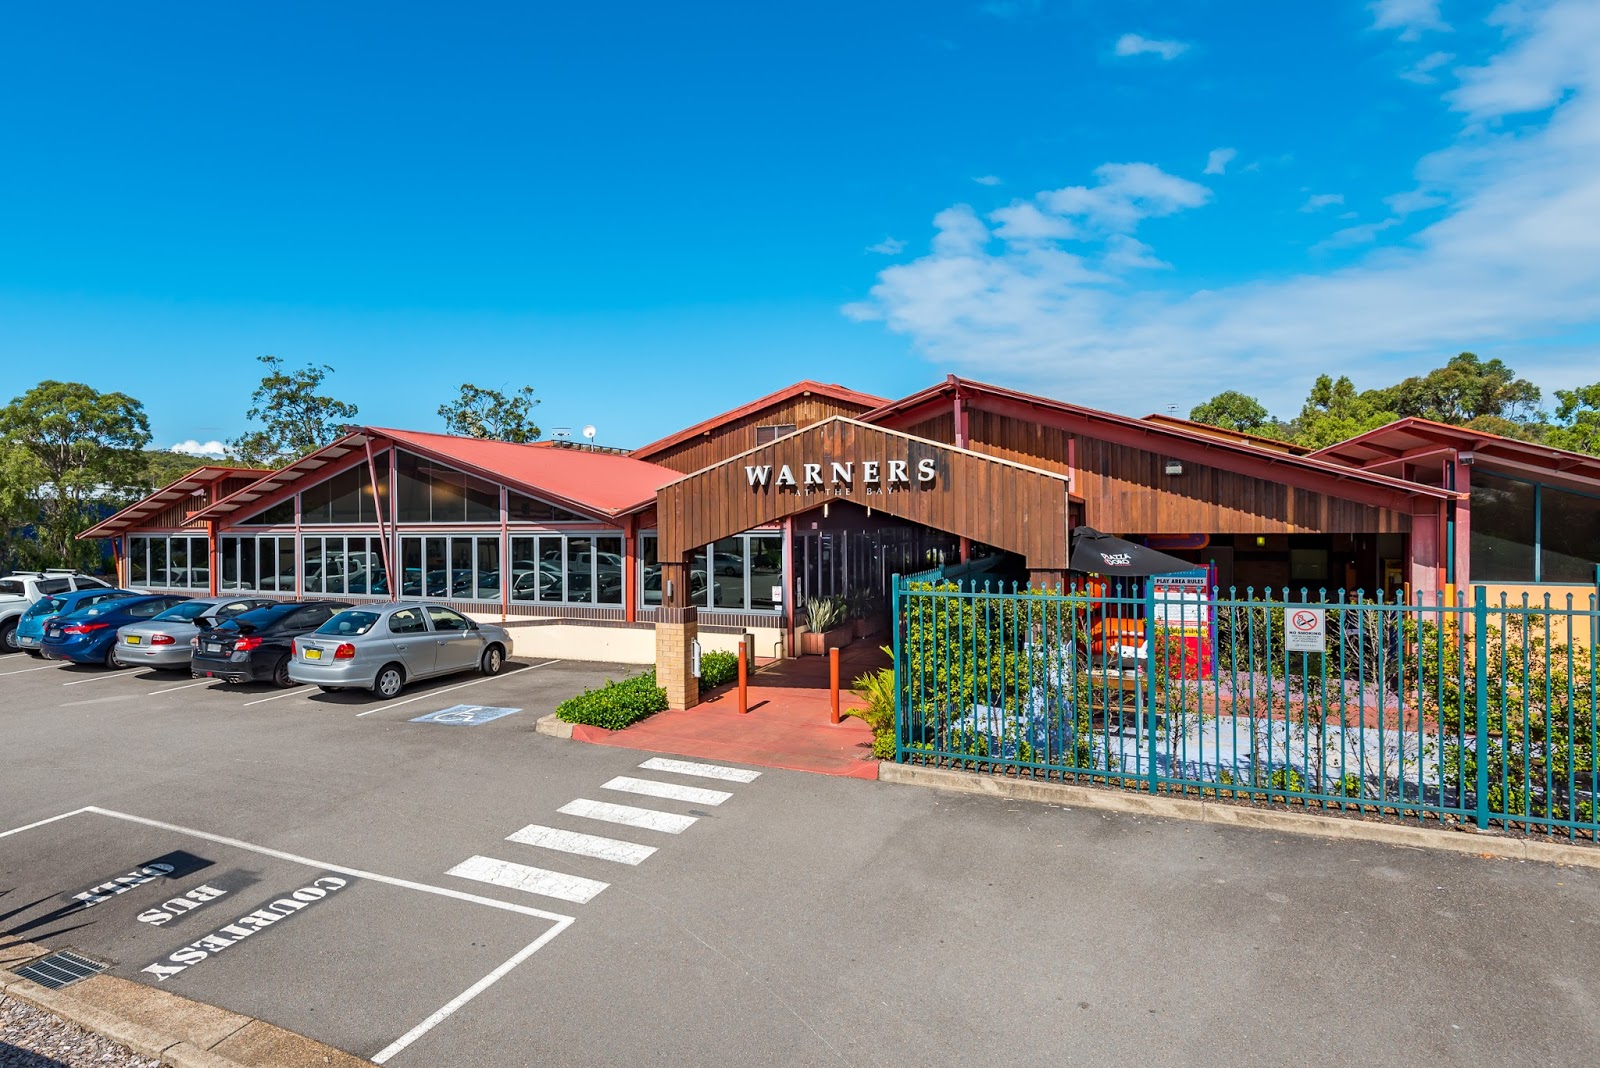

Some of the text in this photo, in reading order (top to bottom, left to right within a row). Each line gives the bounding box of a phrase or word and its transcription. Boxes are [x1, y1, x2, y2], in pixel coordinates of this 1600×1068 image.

[744, 458, 936, 486] WARNERS
[795, 486, 895, 497] AT THE BAY
[72, 863, 175, 908] ONLY
[137, 884, 228, 926] BUS
[140, 876, 347, 982] COURTESY
